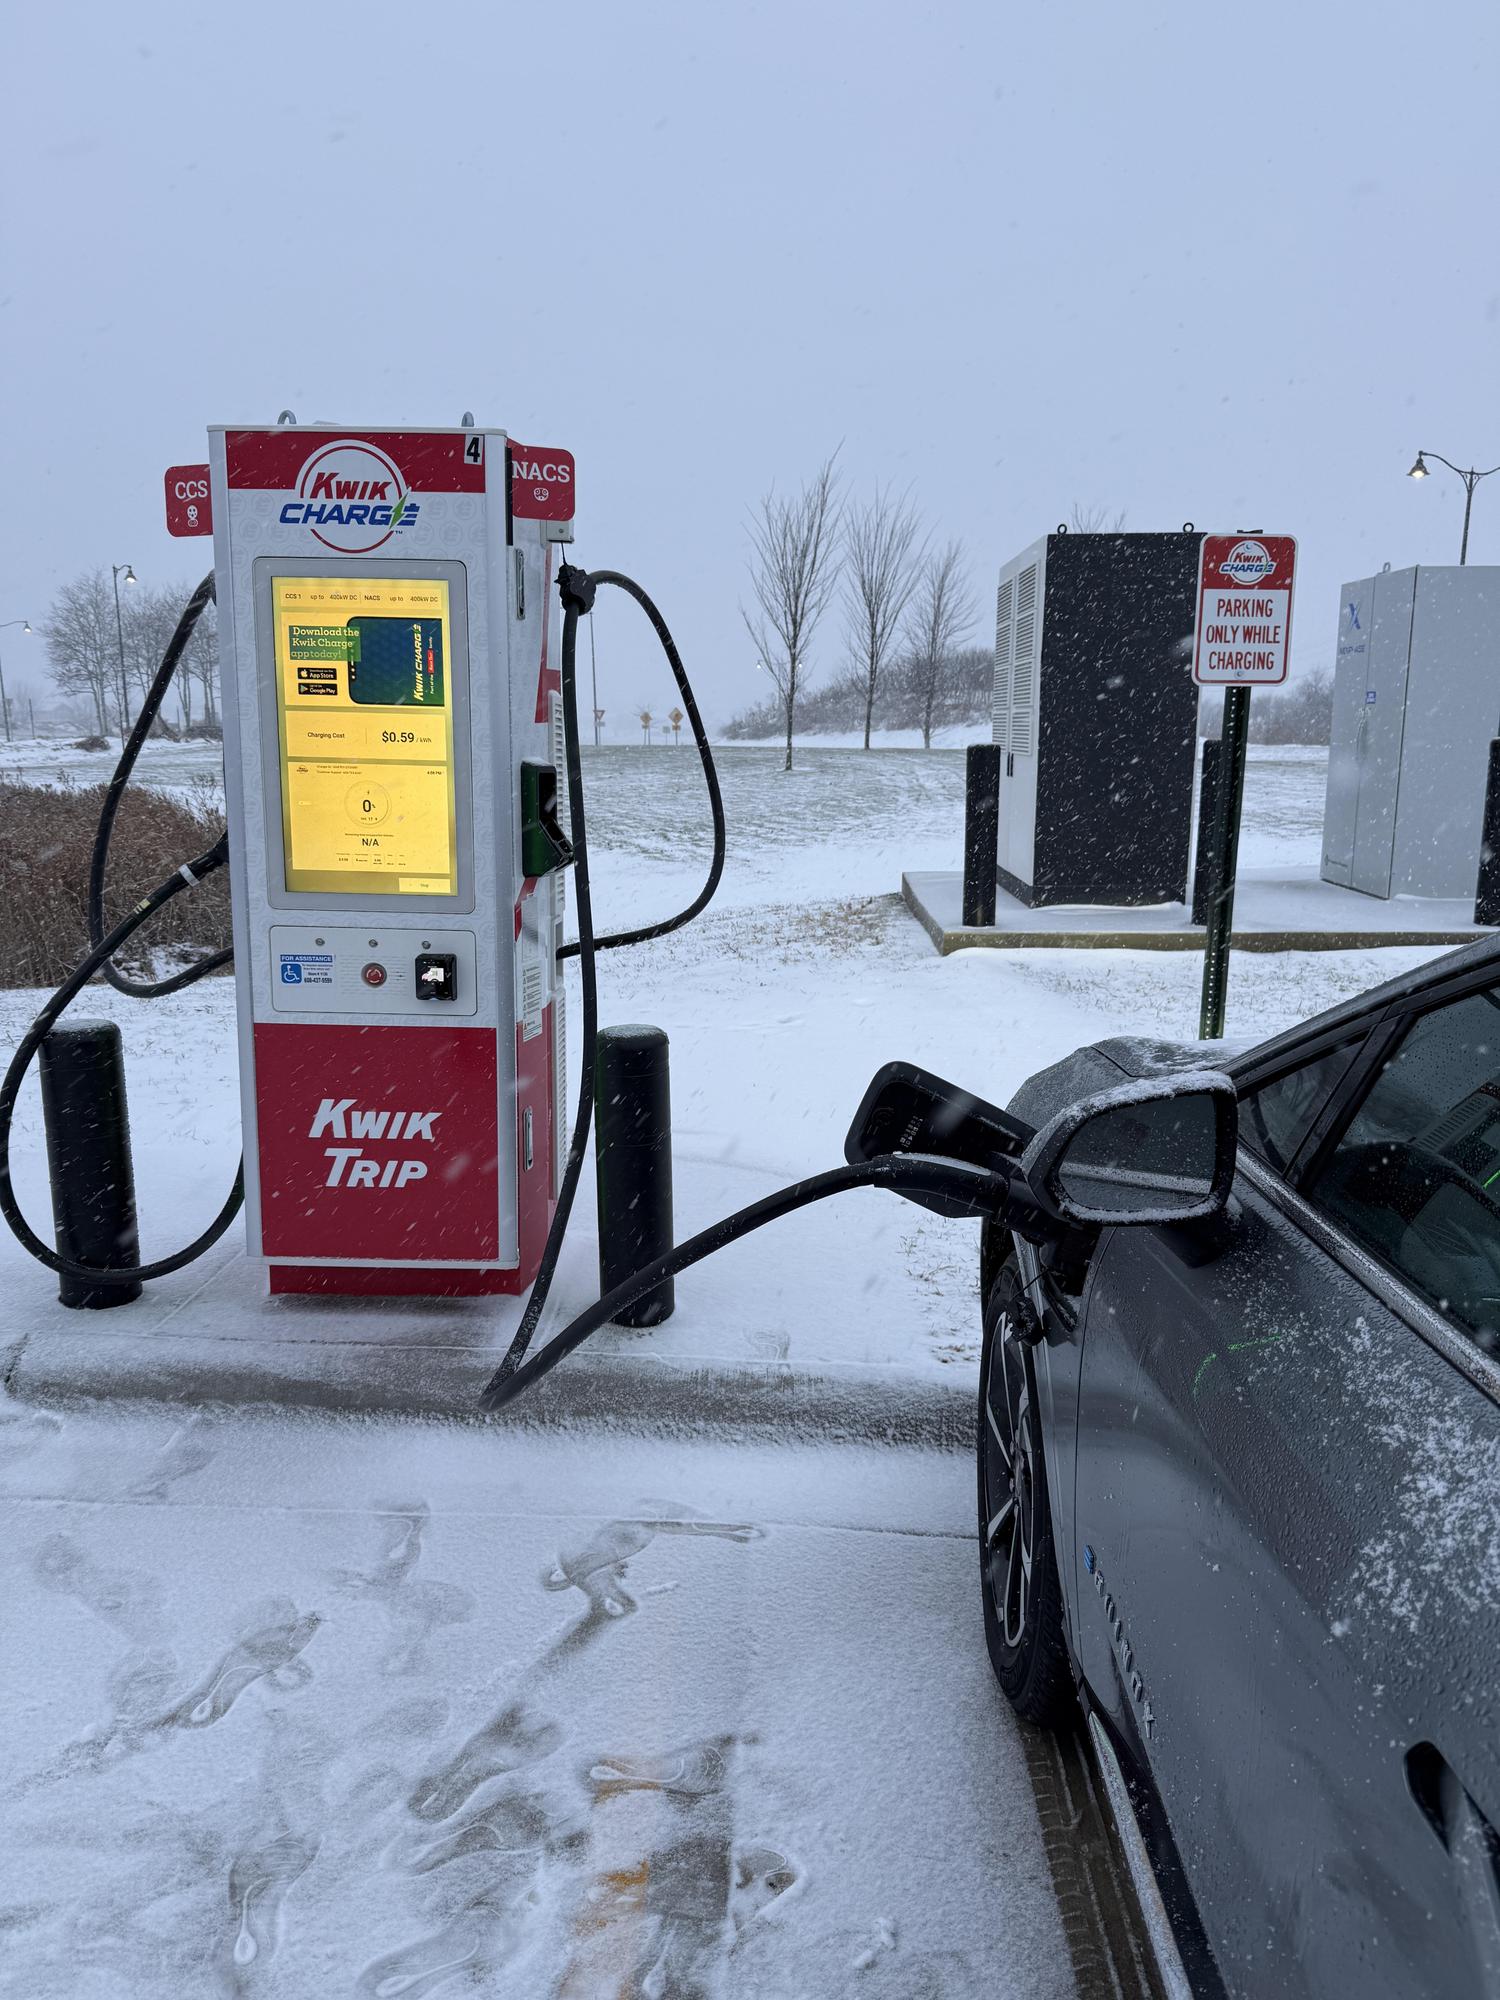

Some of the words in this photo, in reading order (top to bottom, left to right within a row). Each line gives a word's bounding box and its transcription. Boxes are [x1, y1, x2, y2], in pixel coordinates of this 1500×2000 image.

[466, 437, 480, 463] 4
[512, 460, 570, 483] NACS
[175, 480, 208, 500] CCS
[310, 472, 392, 500] KWIK
[280, 502, 420, 526] CHARGE
[1232, 552, 1264, 563] KWIK
[1216, 598, 1274, 618] PARKING
[293, 627, 342, 636] Download
[343, 627, 360, 636] the
[1206, 624, 1239, 644] ONLY
[1242, 626, 1280, 644] WHILE
[292, 638, 317, 647] Kwik
[317, 638, 353, 650] Charge
[291, 651, 310, 659] app
[310, 650, 341, 660] today!
[1208, 651, 1274, 670] CHARGING
[382, 730, 415, 743] $0.59
[362, 838, 379, 846] N/A
[308, 1099, 443, 1139] KWIK
[324, 1148, 428, 1188] TRIP
